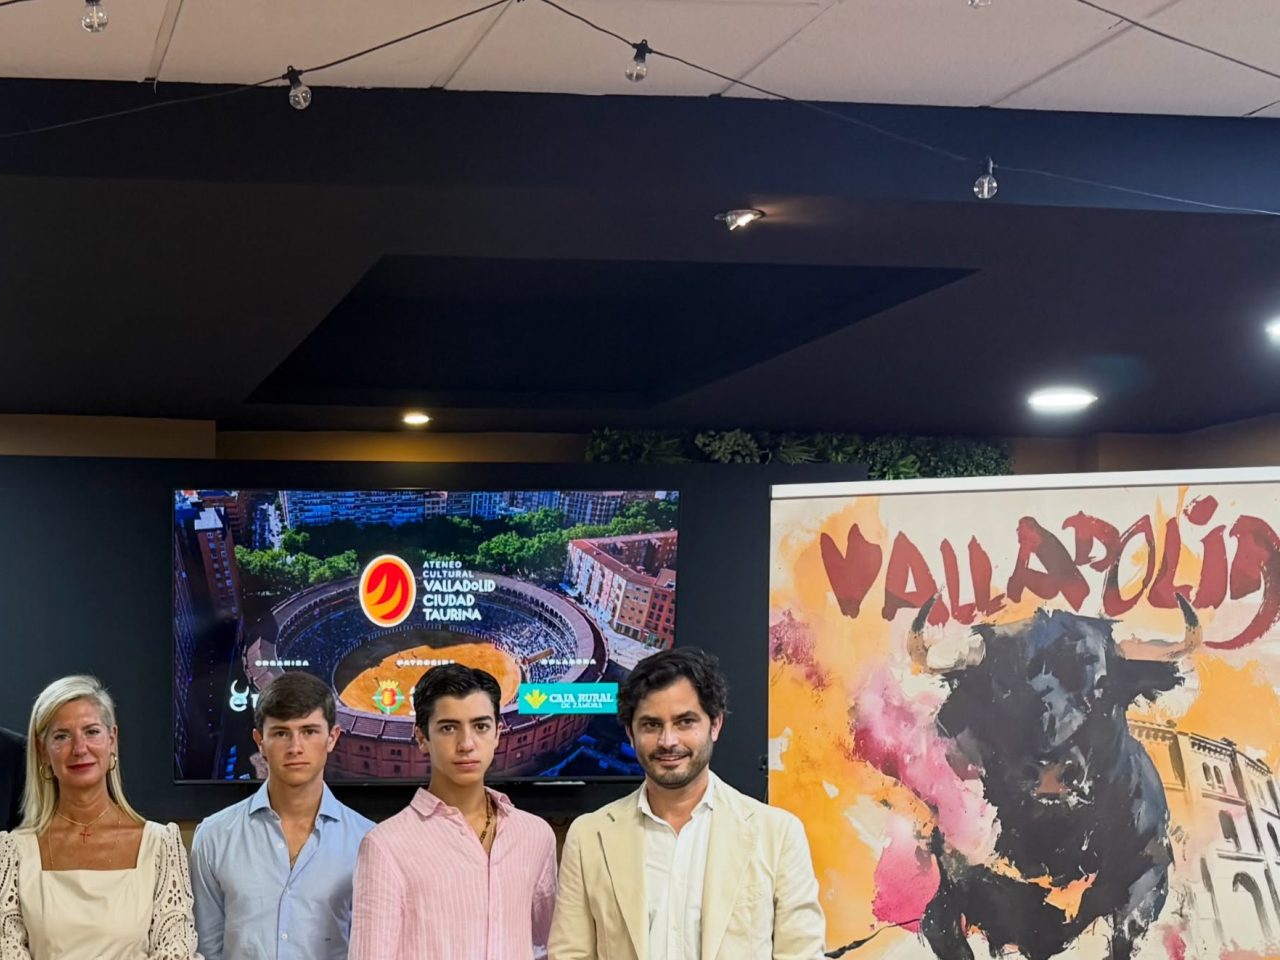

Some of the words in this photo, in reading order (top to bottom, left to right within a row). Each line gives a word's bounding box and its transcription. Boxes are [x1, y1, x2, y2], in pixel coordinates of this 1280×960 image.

[422, 560, 462, 569] ATENEO
[422, 570, 475, 578] CULTURAL
[422, 594, 475, 607] CIUDAD
[422, 608, 482, 621] TAURINA
[577, 693, 614, 703] RURAL
